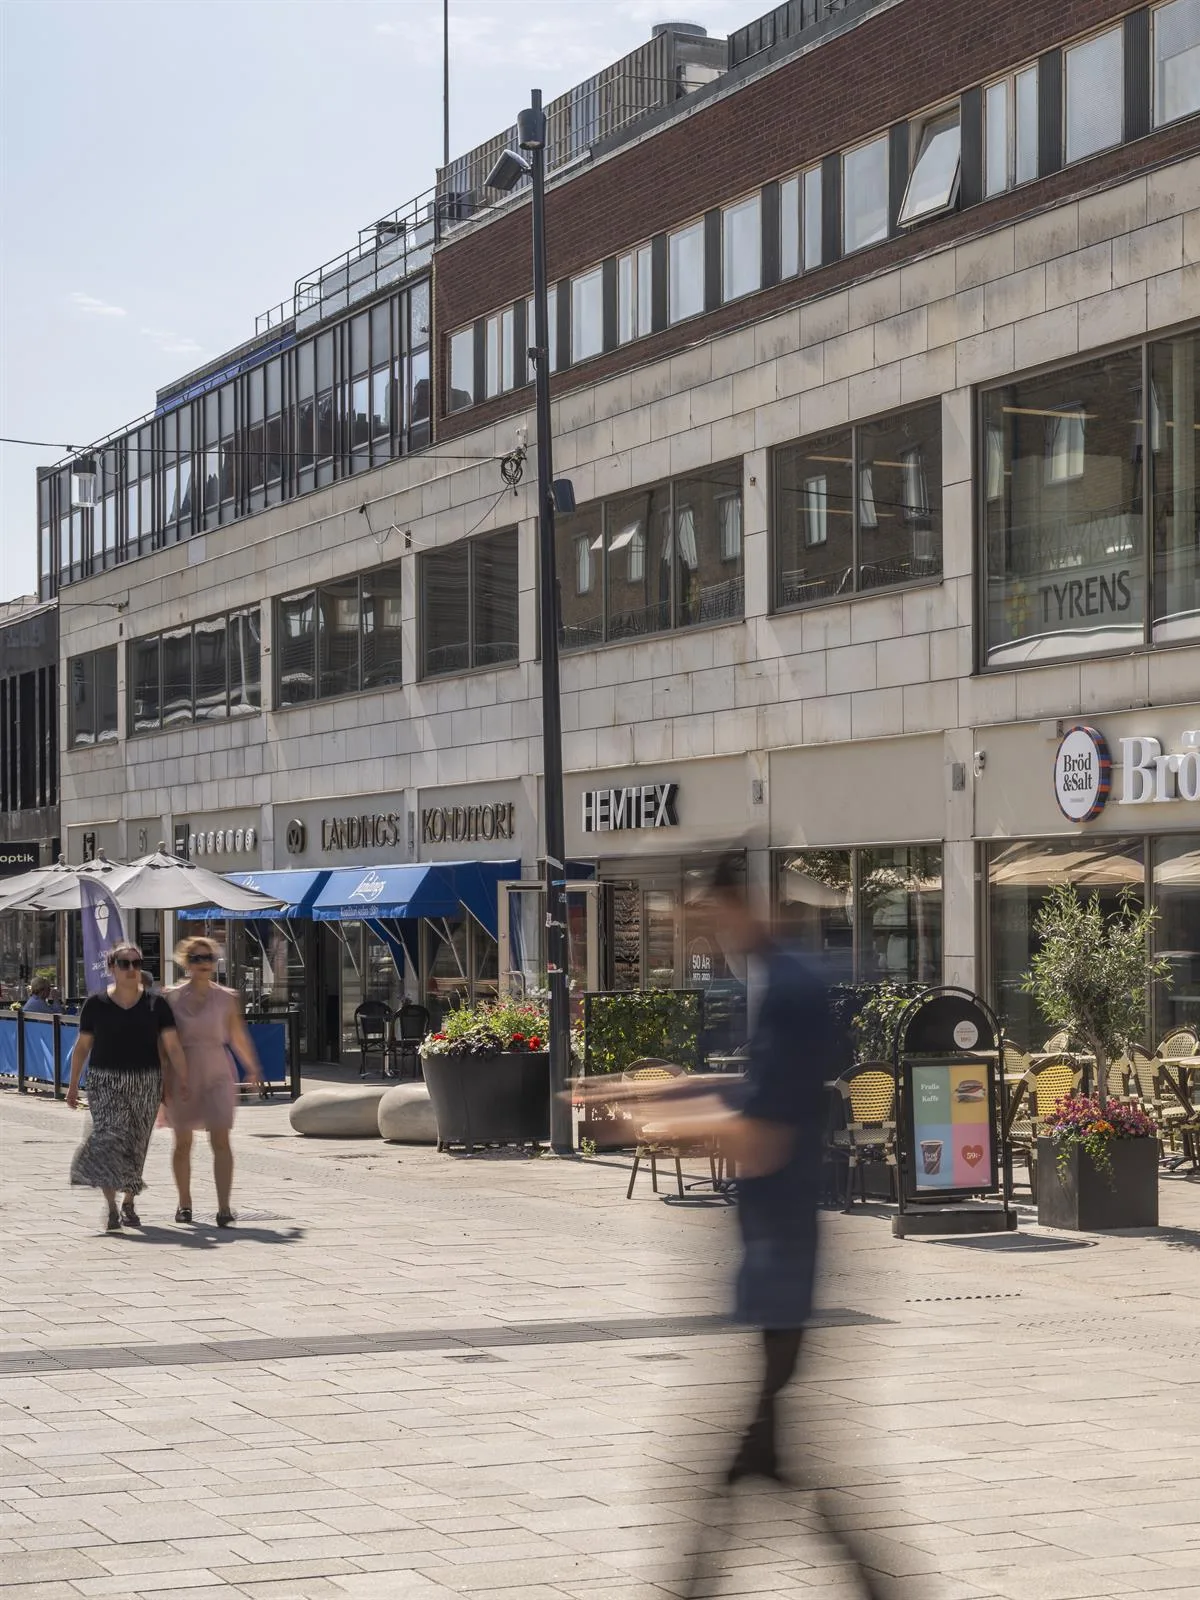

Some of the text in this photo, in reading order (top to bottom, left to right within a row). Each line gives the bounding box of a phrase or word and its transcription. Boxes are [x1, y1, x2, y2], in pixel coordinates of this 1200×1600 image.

[1038, 570, 1131, 623] TYRENS
[1063, 752, 1092, 772] Bröd
[1063, 772, 1093, 792] &Salt
[582, 783, 678, 832] HEMTEX
[321, 802, 514, 851] LANDINGS KONDITORI
[0, 854, 35, 864] optik
